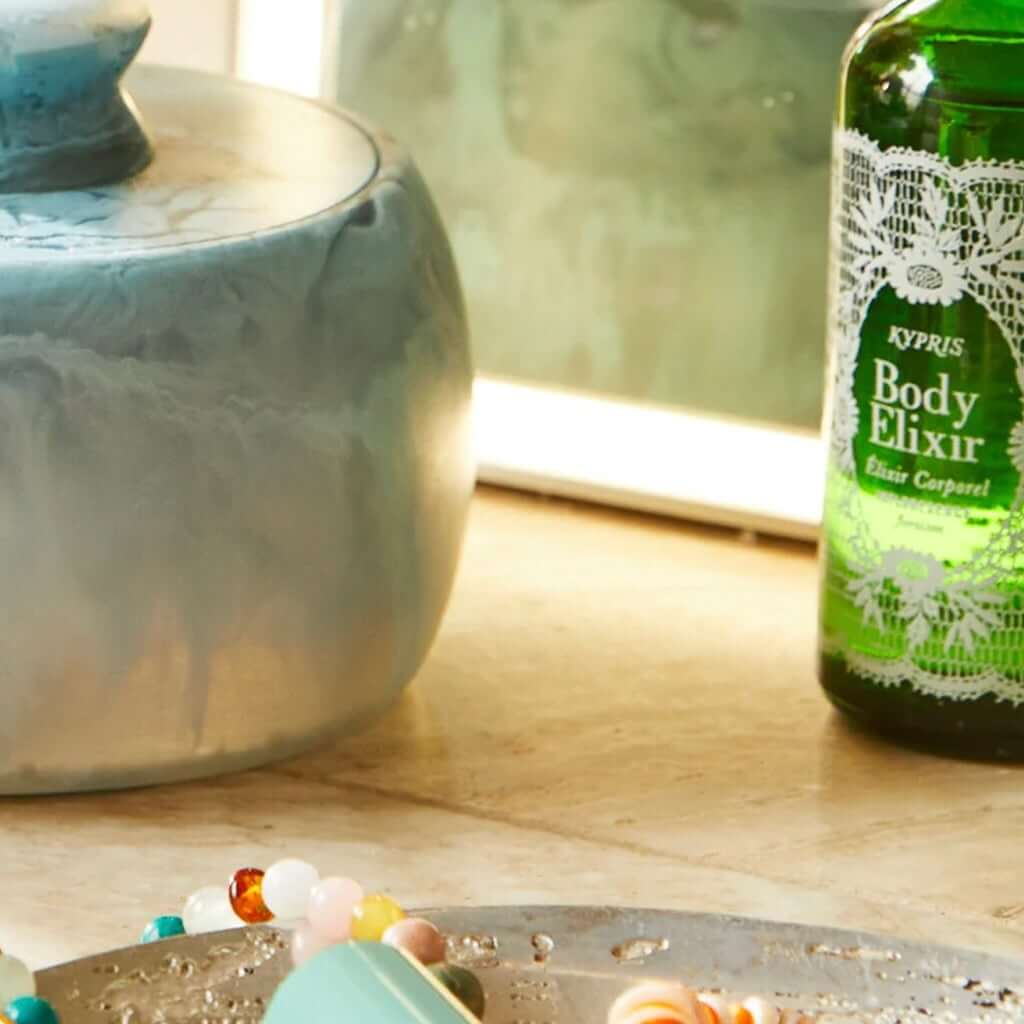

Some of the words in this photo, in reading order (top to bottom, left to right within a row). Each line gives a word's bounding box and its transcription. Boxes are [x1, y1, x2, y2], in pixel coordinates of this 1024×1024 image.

[888, 325, 965, 357] KYPRIS
[873, 358, 980, 429] Body
[868, 401, 985, 463] Elixir
[913, 470, 991, 497] Corporel
